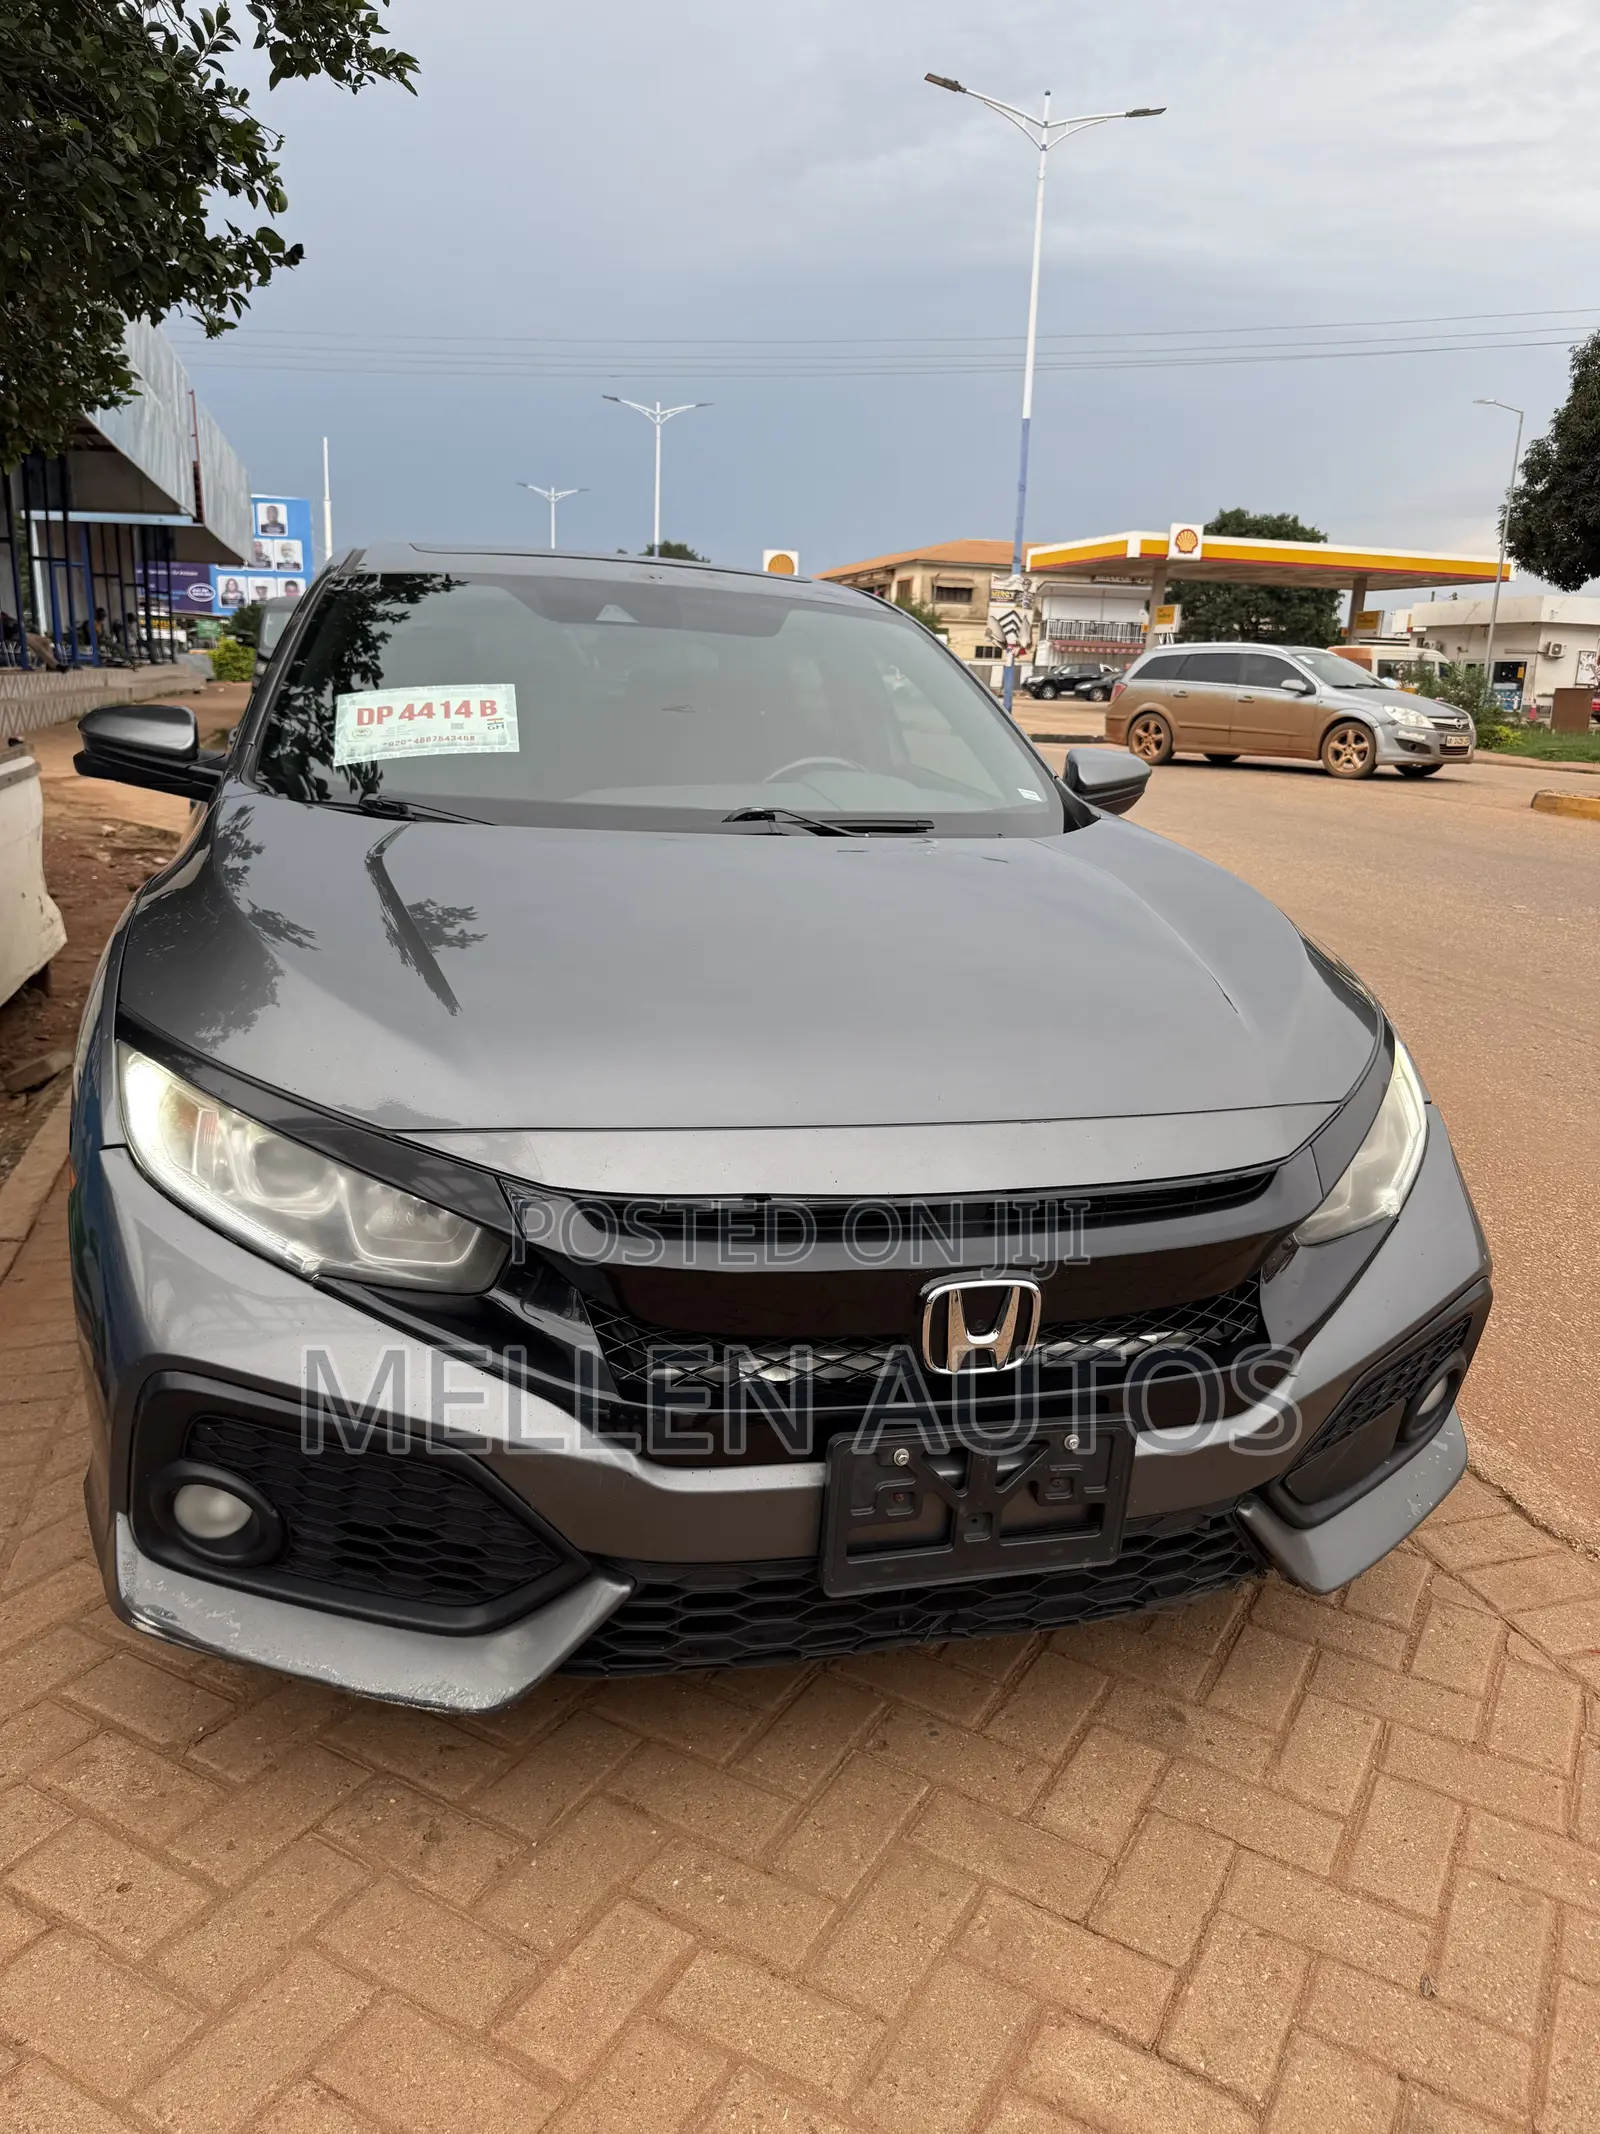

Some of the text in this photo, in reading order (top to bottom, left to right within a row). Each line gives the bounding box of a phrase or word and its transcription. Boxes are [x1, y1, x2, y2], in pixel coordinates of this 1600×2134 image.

[356, 699, 498, 727] DP 4414 B
